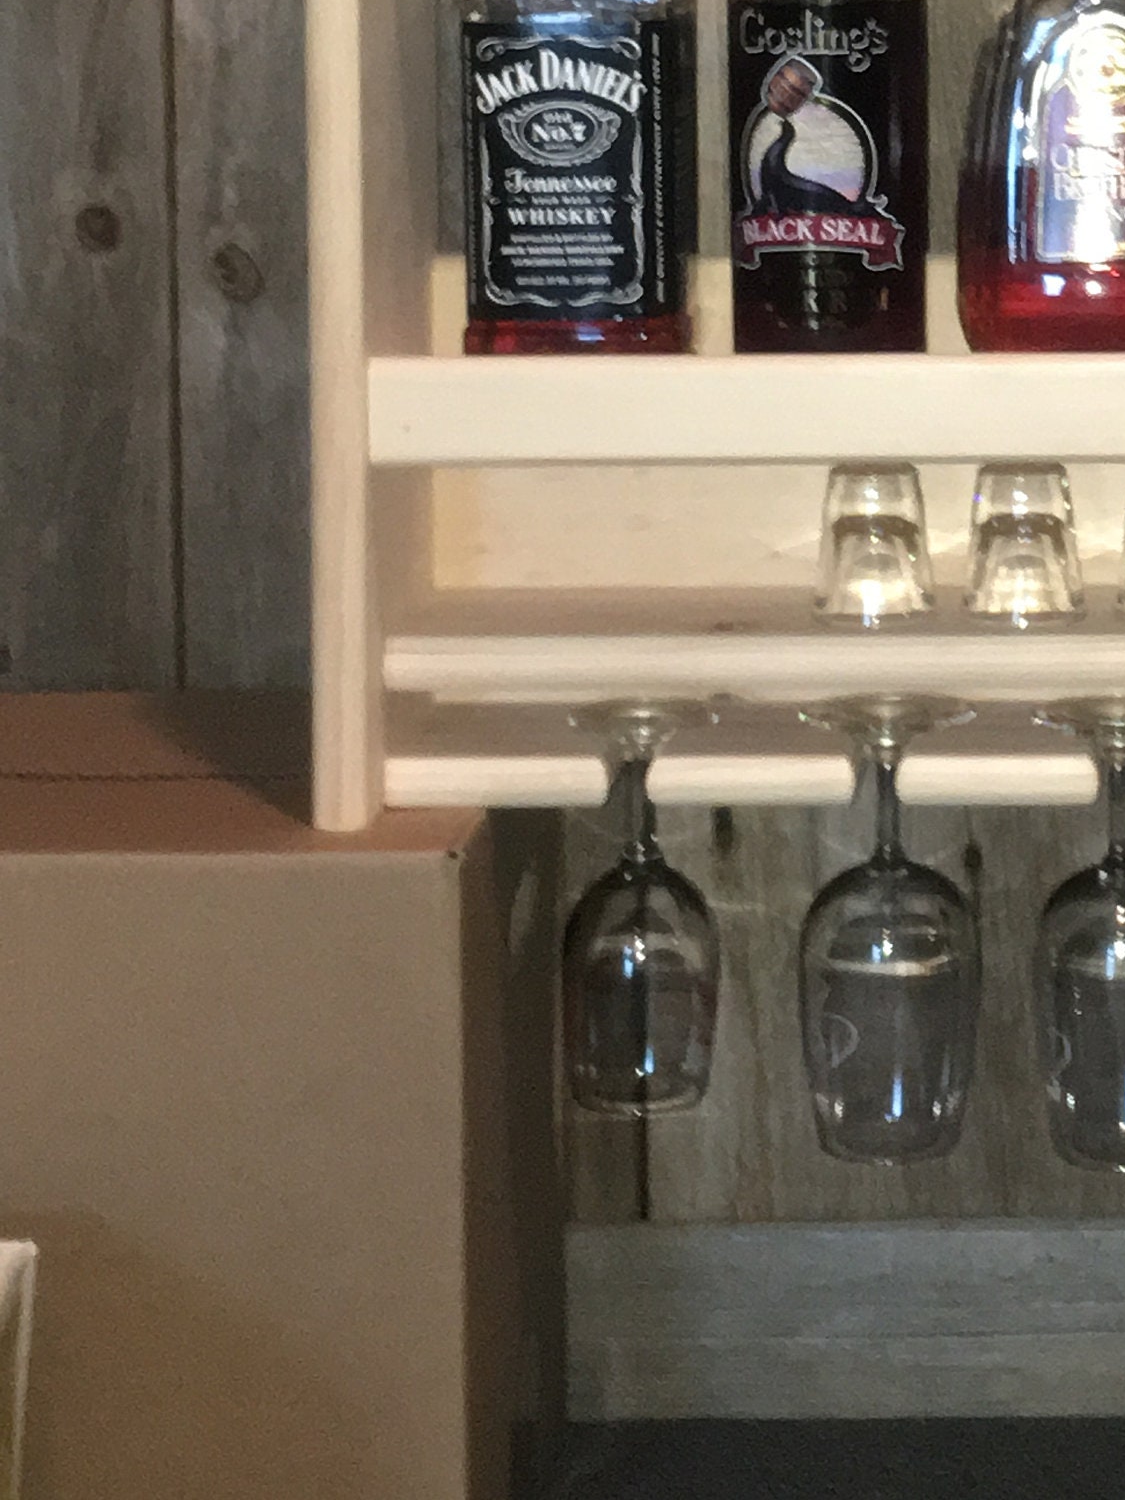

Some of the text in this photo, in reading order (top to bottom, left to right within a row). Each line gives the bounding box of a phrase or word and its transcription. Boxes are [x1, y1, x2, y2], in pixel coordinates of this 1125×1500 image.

[739, 8, 889, 73] Gosling's
[475, 48, 648, 115] JACK DANIEL'S
[503, 166, 618, 194] Tennessee
[507, 206, 617, 226] WHISKEY
[742, 215, 886, 246] BLACK SEAL
